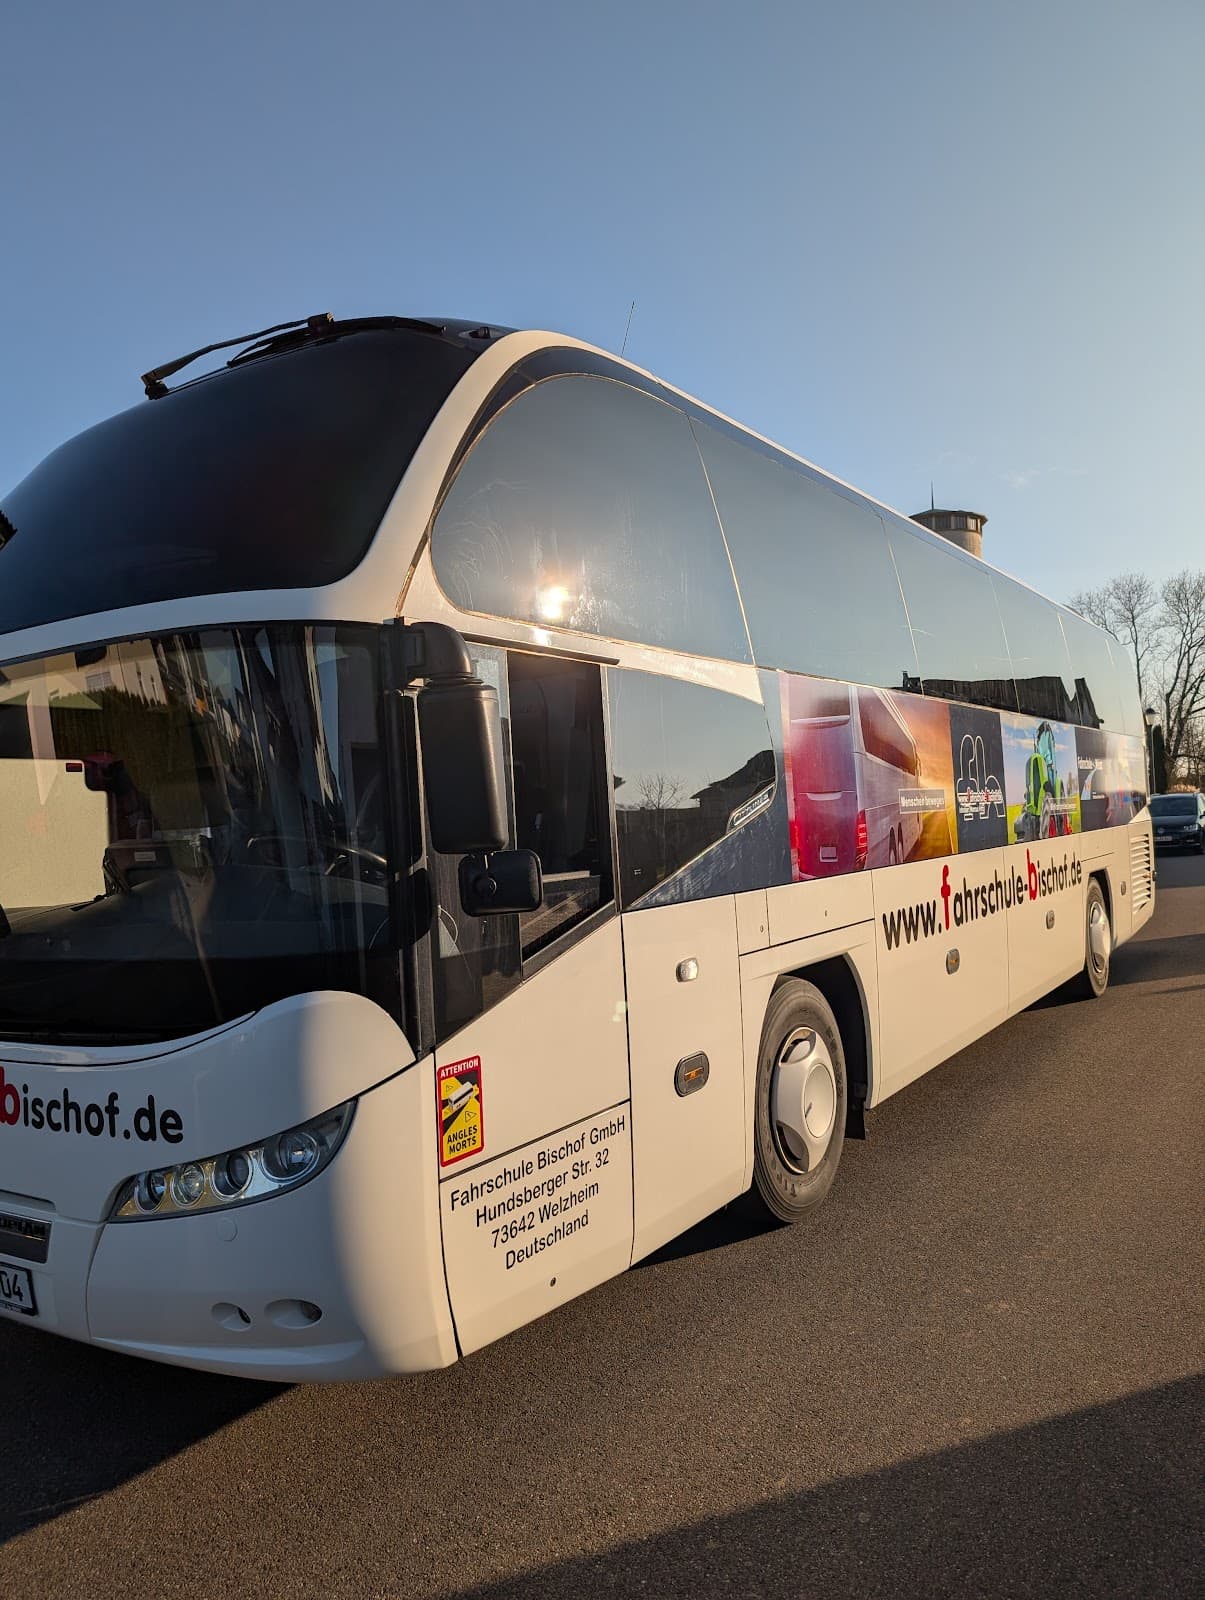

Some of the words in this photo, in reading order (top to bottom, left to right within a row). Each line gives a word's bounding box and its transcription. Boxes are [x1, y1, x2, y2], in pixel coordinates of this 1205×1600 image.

[882, 848, 1083, 951] www.fahrschule-bischof.de
[440, 1058, 479, 1079] ATTENTION
[0, 1066, 183, 1143] bischof.de
[447, 1125, 478, 1144] ANGLES
[449, 1136, 477, 1155] MORTS
[450, 1160, 533, 1211] Fahrschule
[537, 1132, 586, 1171] Bischof
[590, 1115, 625, 1144] GmbH
[476, 1172, 568, 1227] Hundsberger
[572, 1159, 592, 1180] Str.
[595, 1148, 610, 1169] 32
[491, 1211, 536, 1248] 73642
[538, 1181, 599, 1224] Welzheim
[505, 1209, 589, 1270] Deutschland
